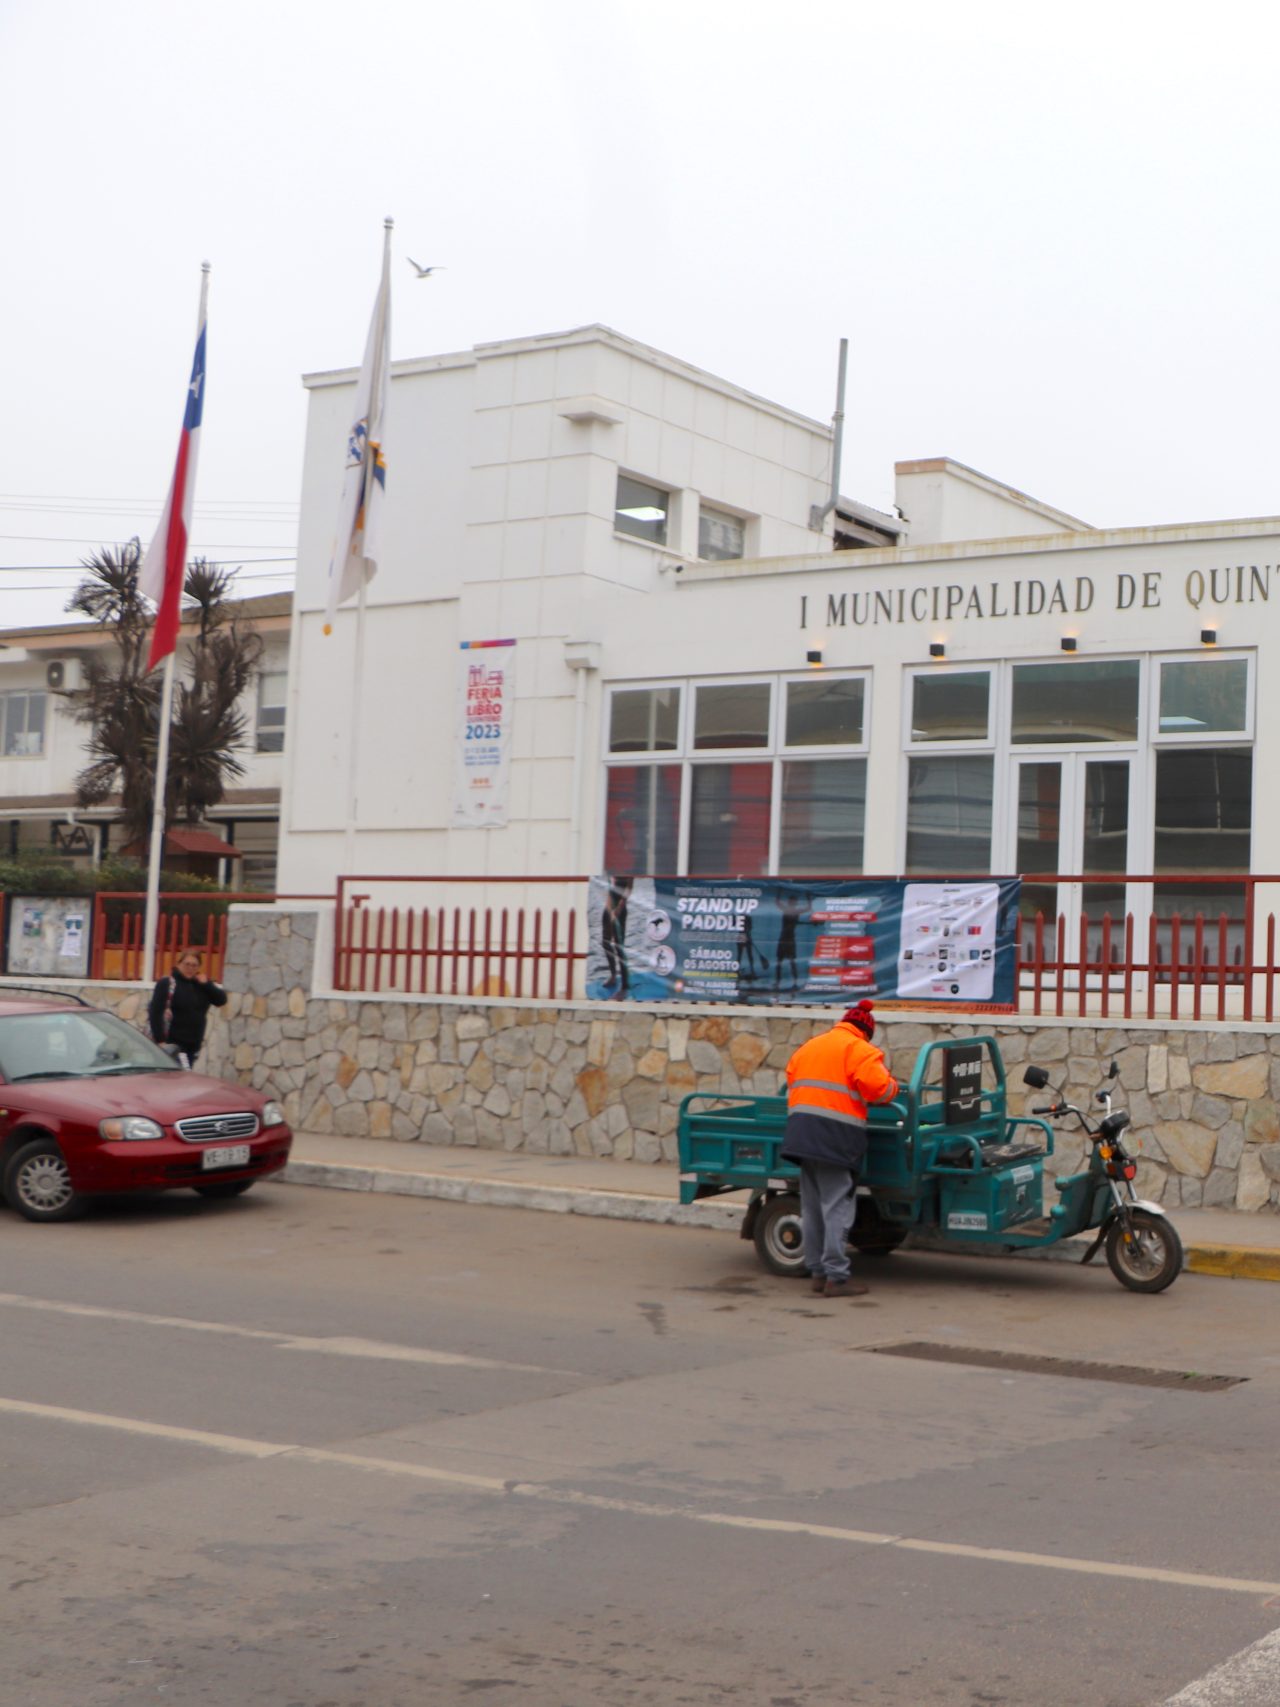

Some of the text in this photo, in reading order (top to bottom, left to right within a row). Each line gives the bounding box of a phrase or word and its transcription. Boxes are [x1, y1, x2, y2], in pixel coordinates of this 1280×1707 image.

[800, 596, 807, 628] I
[826, 577, 1094, 626] MUNICIPALIDAD
[1116, 572, 1161, 609] DE
[467, 687, 502, 700] FERIA
[467, 703, 502, 716] LIBRO
[465, 724, 501, 739] 2023
[677, 898, 759, 913] STAND UP
[682, 915, 746, 931] PADDLE
[689, 946, 733, 960] SÁBADO
[683, 959, 740, 970] 05 AGOSTO
